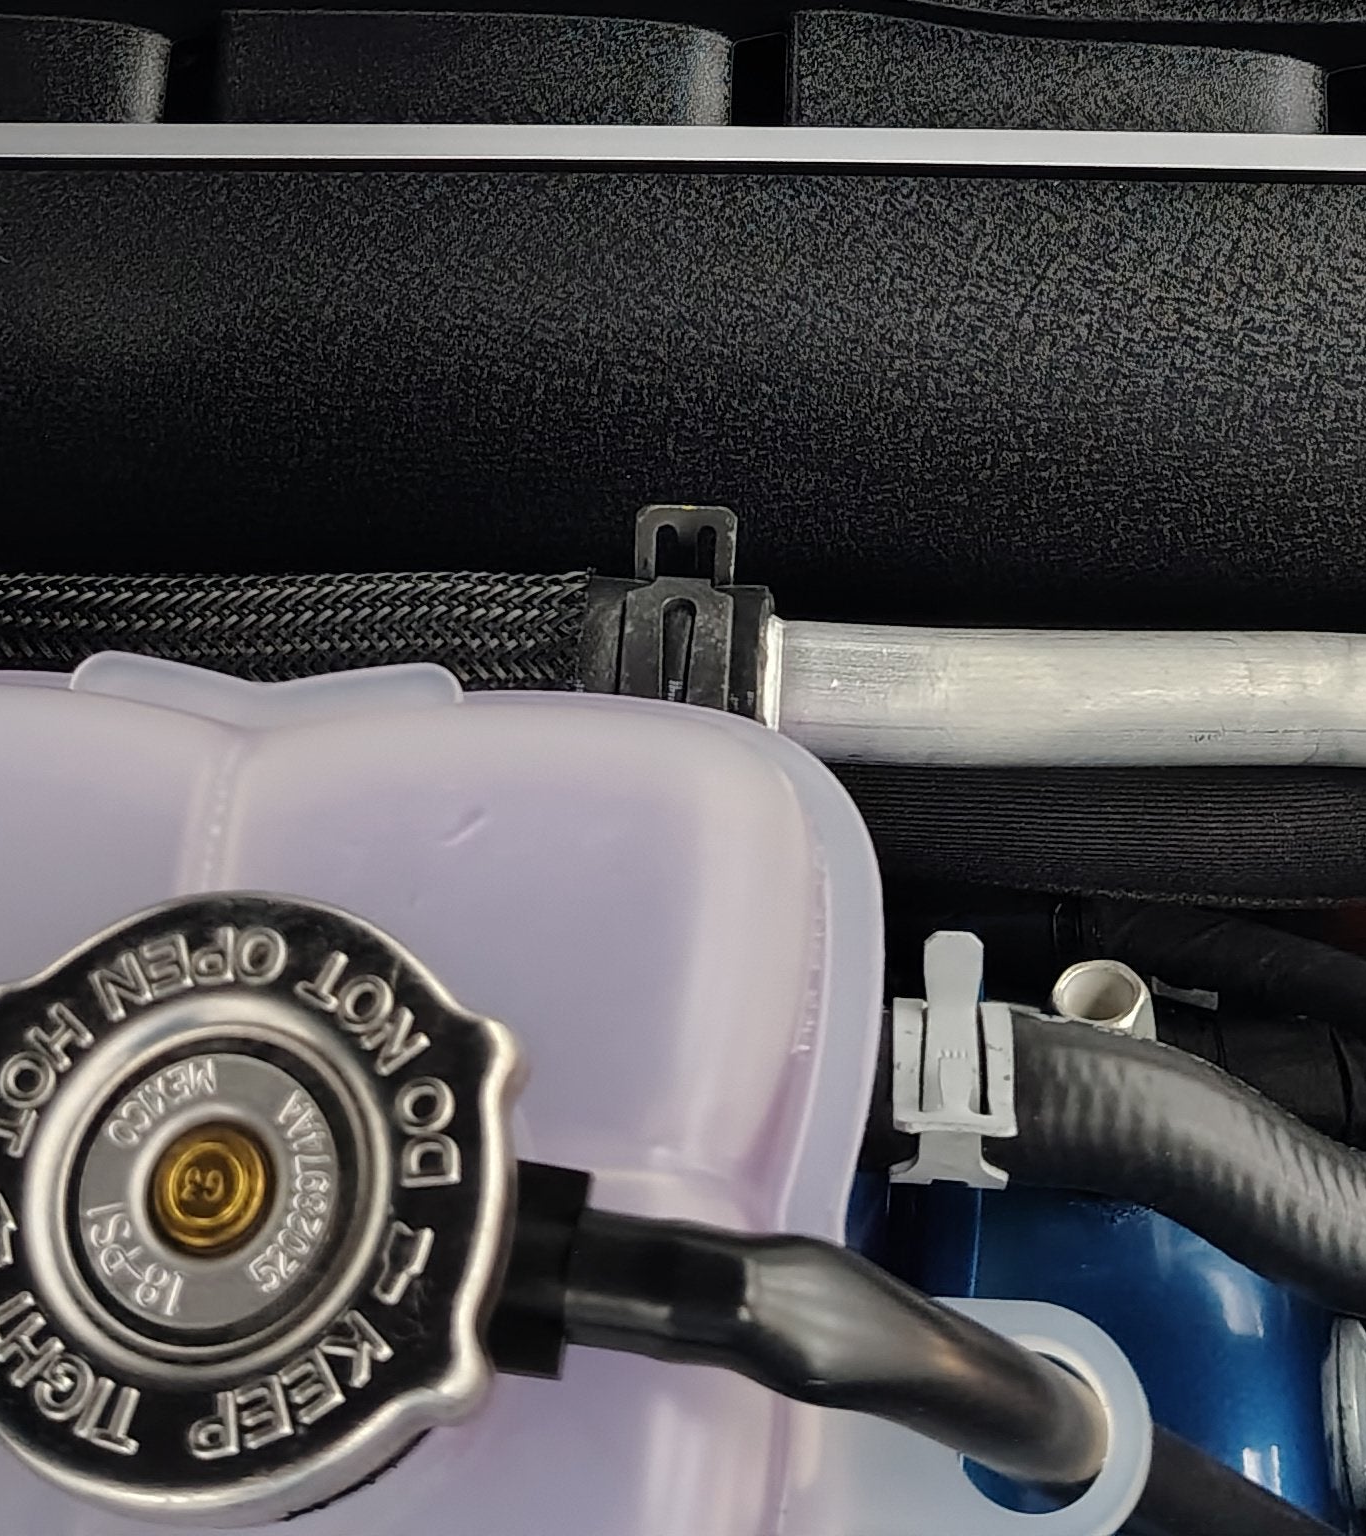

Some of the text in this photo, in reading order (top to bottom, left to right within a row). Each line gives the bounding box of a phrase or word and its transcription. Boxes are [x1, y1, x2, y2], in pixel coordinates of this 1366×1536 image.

[89, 925, 287, 1022] OPEN
[295, 951, 431, 1076] NOT
[108, 1058, 217, 1147] MEXICO
[395, 1075, 461, 1188] DO
[189, 1309, 394, 1460] KEEP
